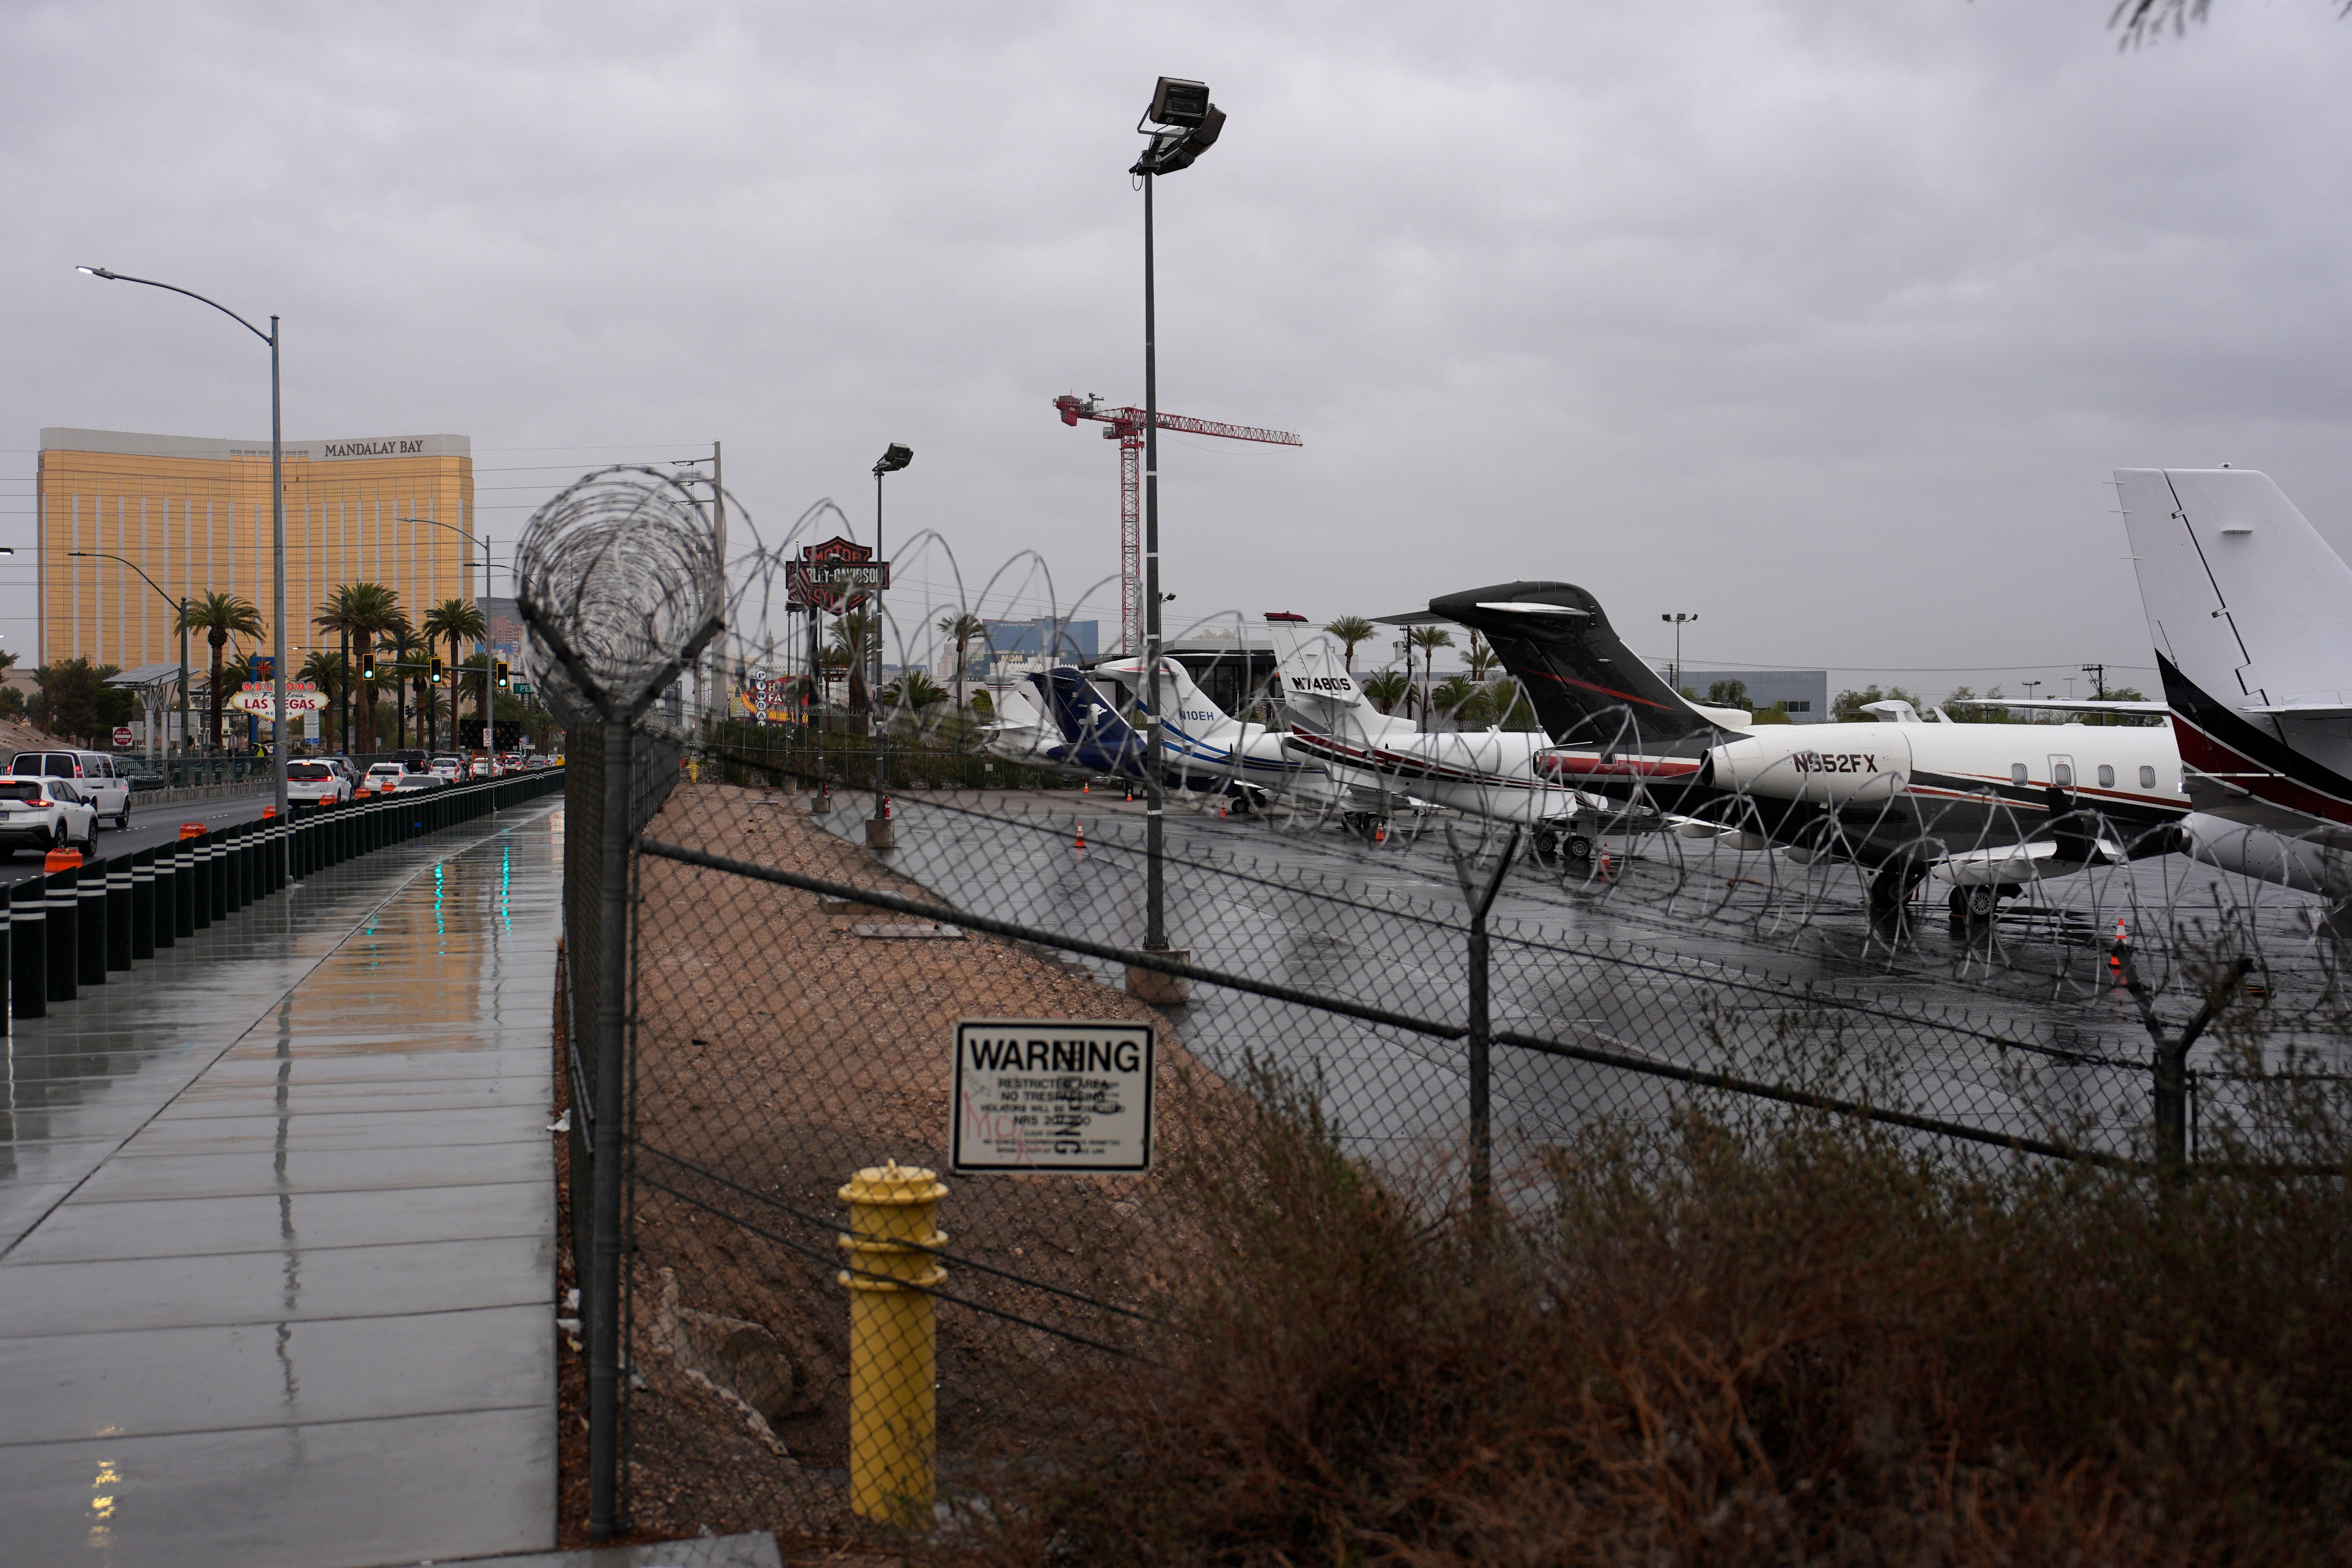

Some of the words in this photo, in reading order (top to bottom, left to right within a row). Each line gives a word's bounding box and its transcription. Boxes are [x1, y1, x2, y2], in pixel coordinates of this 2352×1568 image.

[325, 442, 396, 457] MANDALAY
[400, 440, 423, 453] BAY
[245, 699, 268, 709] LAS
[1178, 710, 1214, 721] N10EH
[970, 1038, 1139, 1072] WARNING
[1001, 1090, 1019, 1101] NO
[1014, 1115, 1038, 1125] NRS
